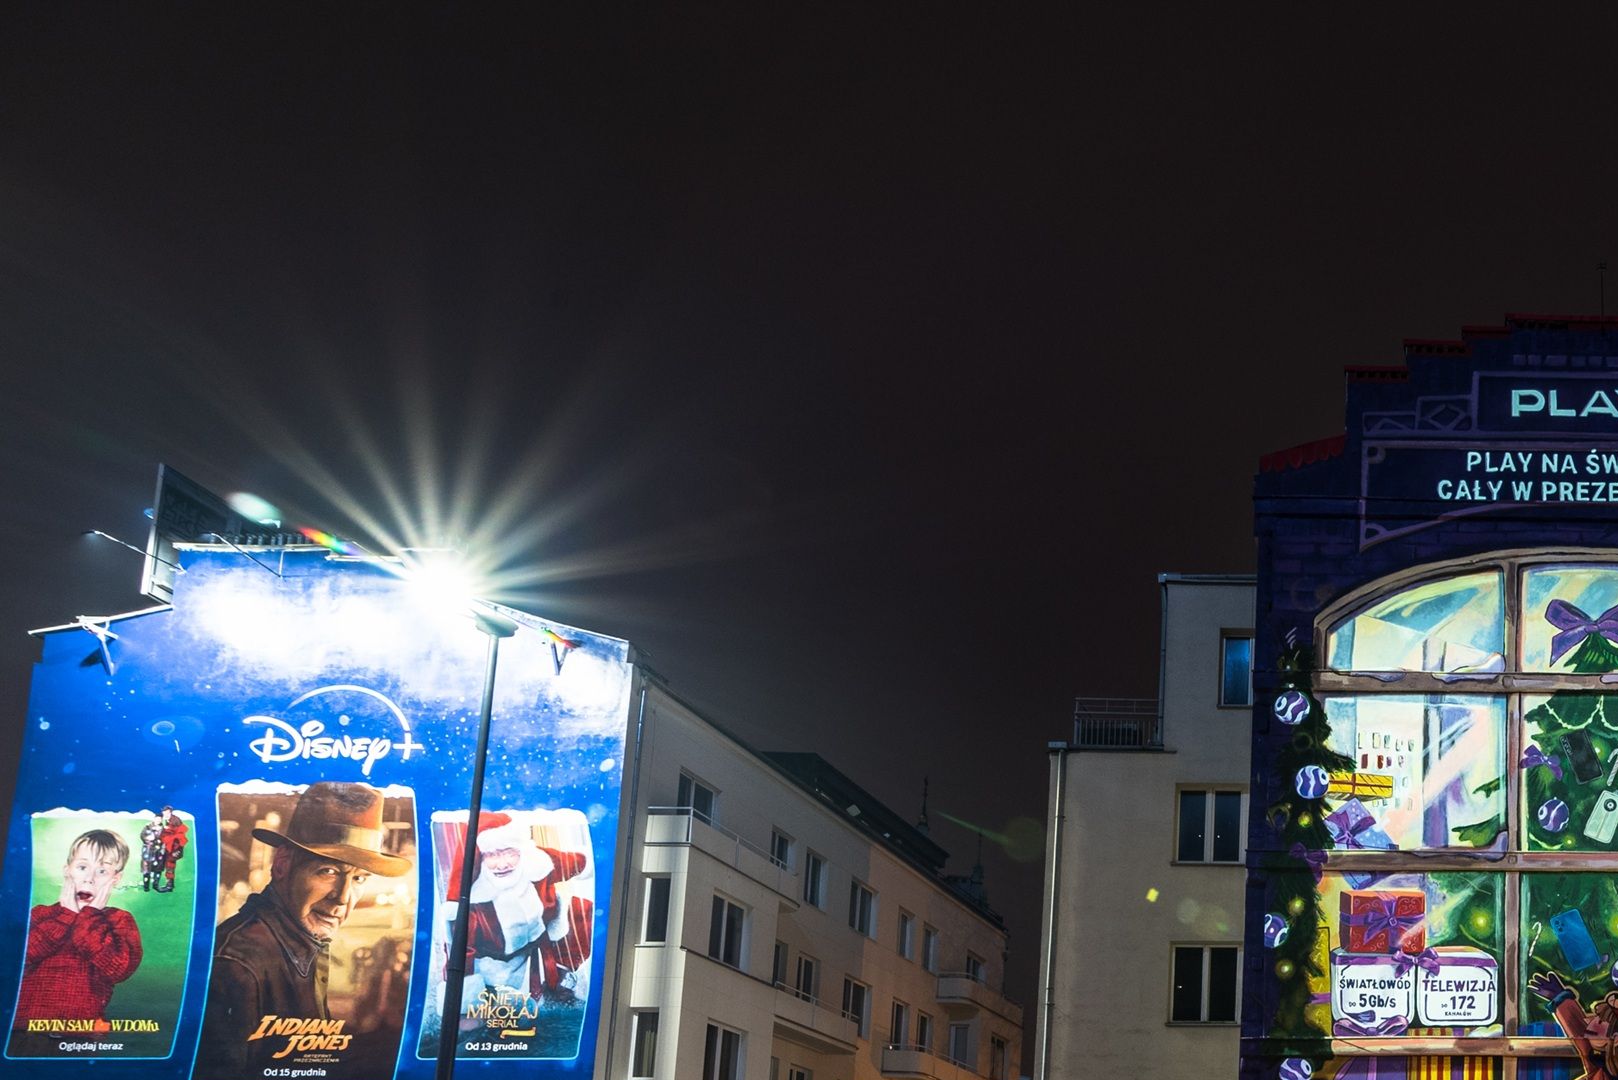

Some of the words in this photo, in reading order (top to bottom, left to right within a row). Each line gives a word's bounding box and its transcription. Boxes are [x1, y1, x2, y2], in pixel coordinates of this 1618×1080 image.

[1466, 451, 1533, 473] PLAY
[1541, 452, 1578, 474] NA
[1437, 479, 1503, 500] CAŁY
[1511, 480, 1533, 501] W
[1339, 976, 1411, 990] ŚWIATŁOWÓD
[1422, 979, 1497, 993] TELEWIZJA
[1450, 995, 1476, 1010] 172
[466, 1003, 539, 1019] MIKOŁAJ
[27, 1019, 66, 1032] KEVIN
[66, 1019, 94, 1032] SAM
[111, 1019, 125, 1032] W
[246, 1015, 347, 1042] INDIANA
[486, 1019, 519, 1028] SERIAL
[58, 1041, 97, 1052] Oglądaj
[99, 1042, 124, 1051] teraz
[272, 1034, 353, 1059] JONES
[465, 1042, 479, 1051] Od
[480, 1042, 492, 1051] 13
[492, 1041, 528, 1052] grudnia
[263, 1068, 278, 1077] Od
[279, 1068, 291, 1077] 15
[291, 1067, 327, 1078] grudnia
